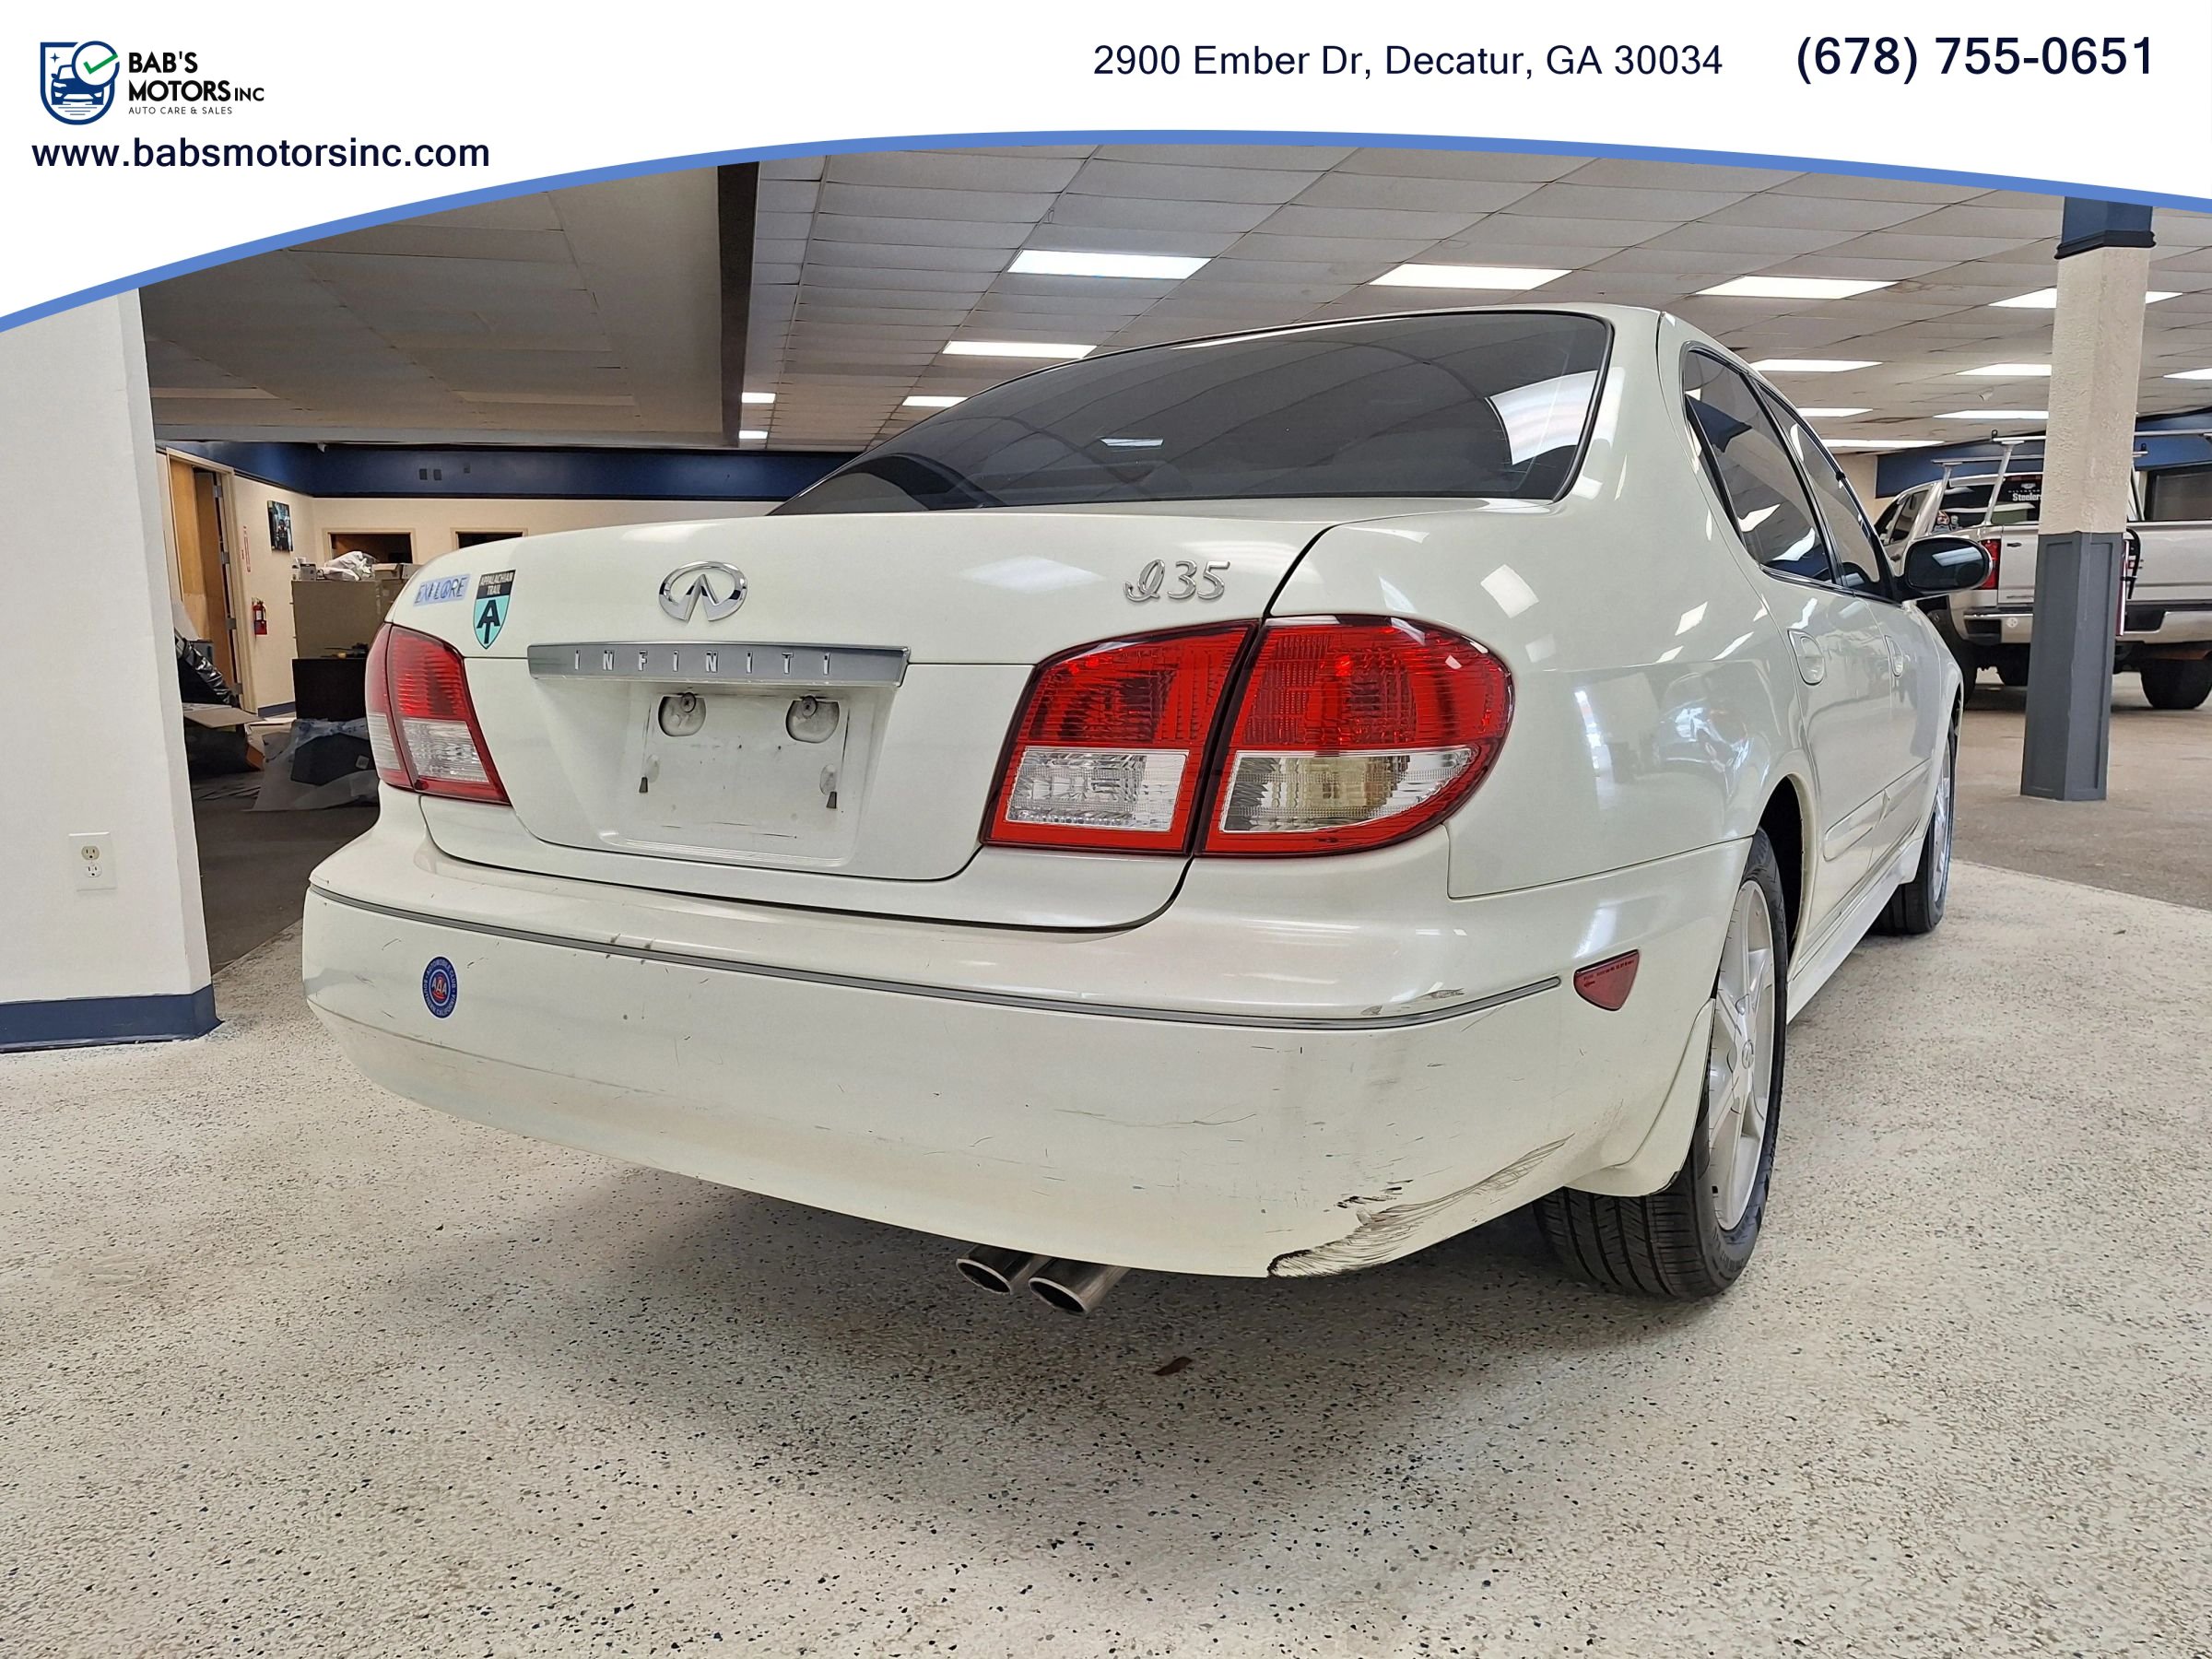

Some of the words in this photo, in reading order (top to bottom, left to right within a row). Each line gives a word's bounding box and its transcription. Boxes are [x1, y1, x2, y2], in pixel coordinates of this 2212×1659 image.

[478, 571, 514, 586] APPALACHIAN
[487, 584, 501, 595] TRAIL
[573, 650, 830, 675] INFINITI
[431, 976, 447, 995] AAA
